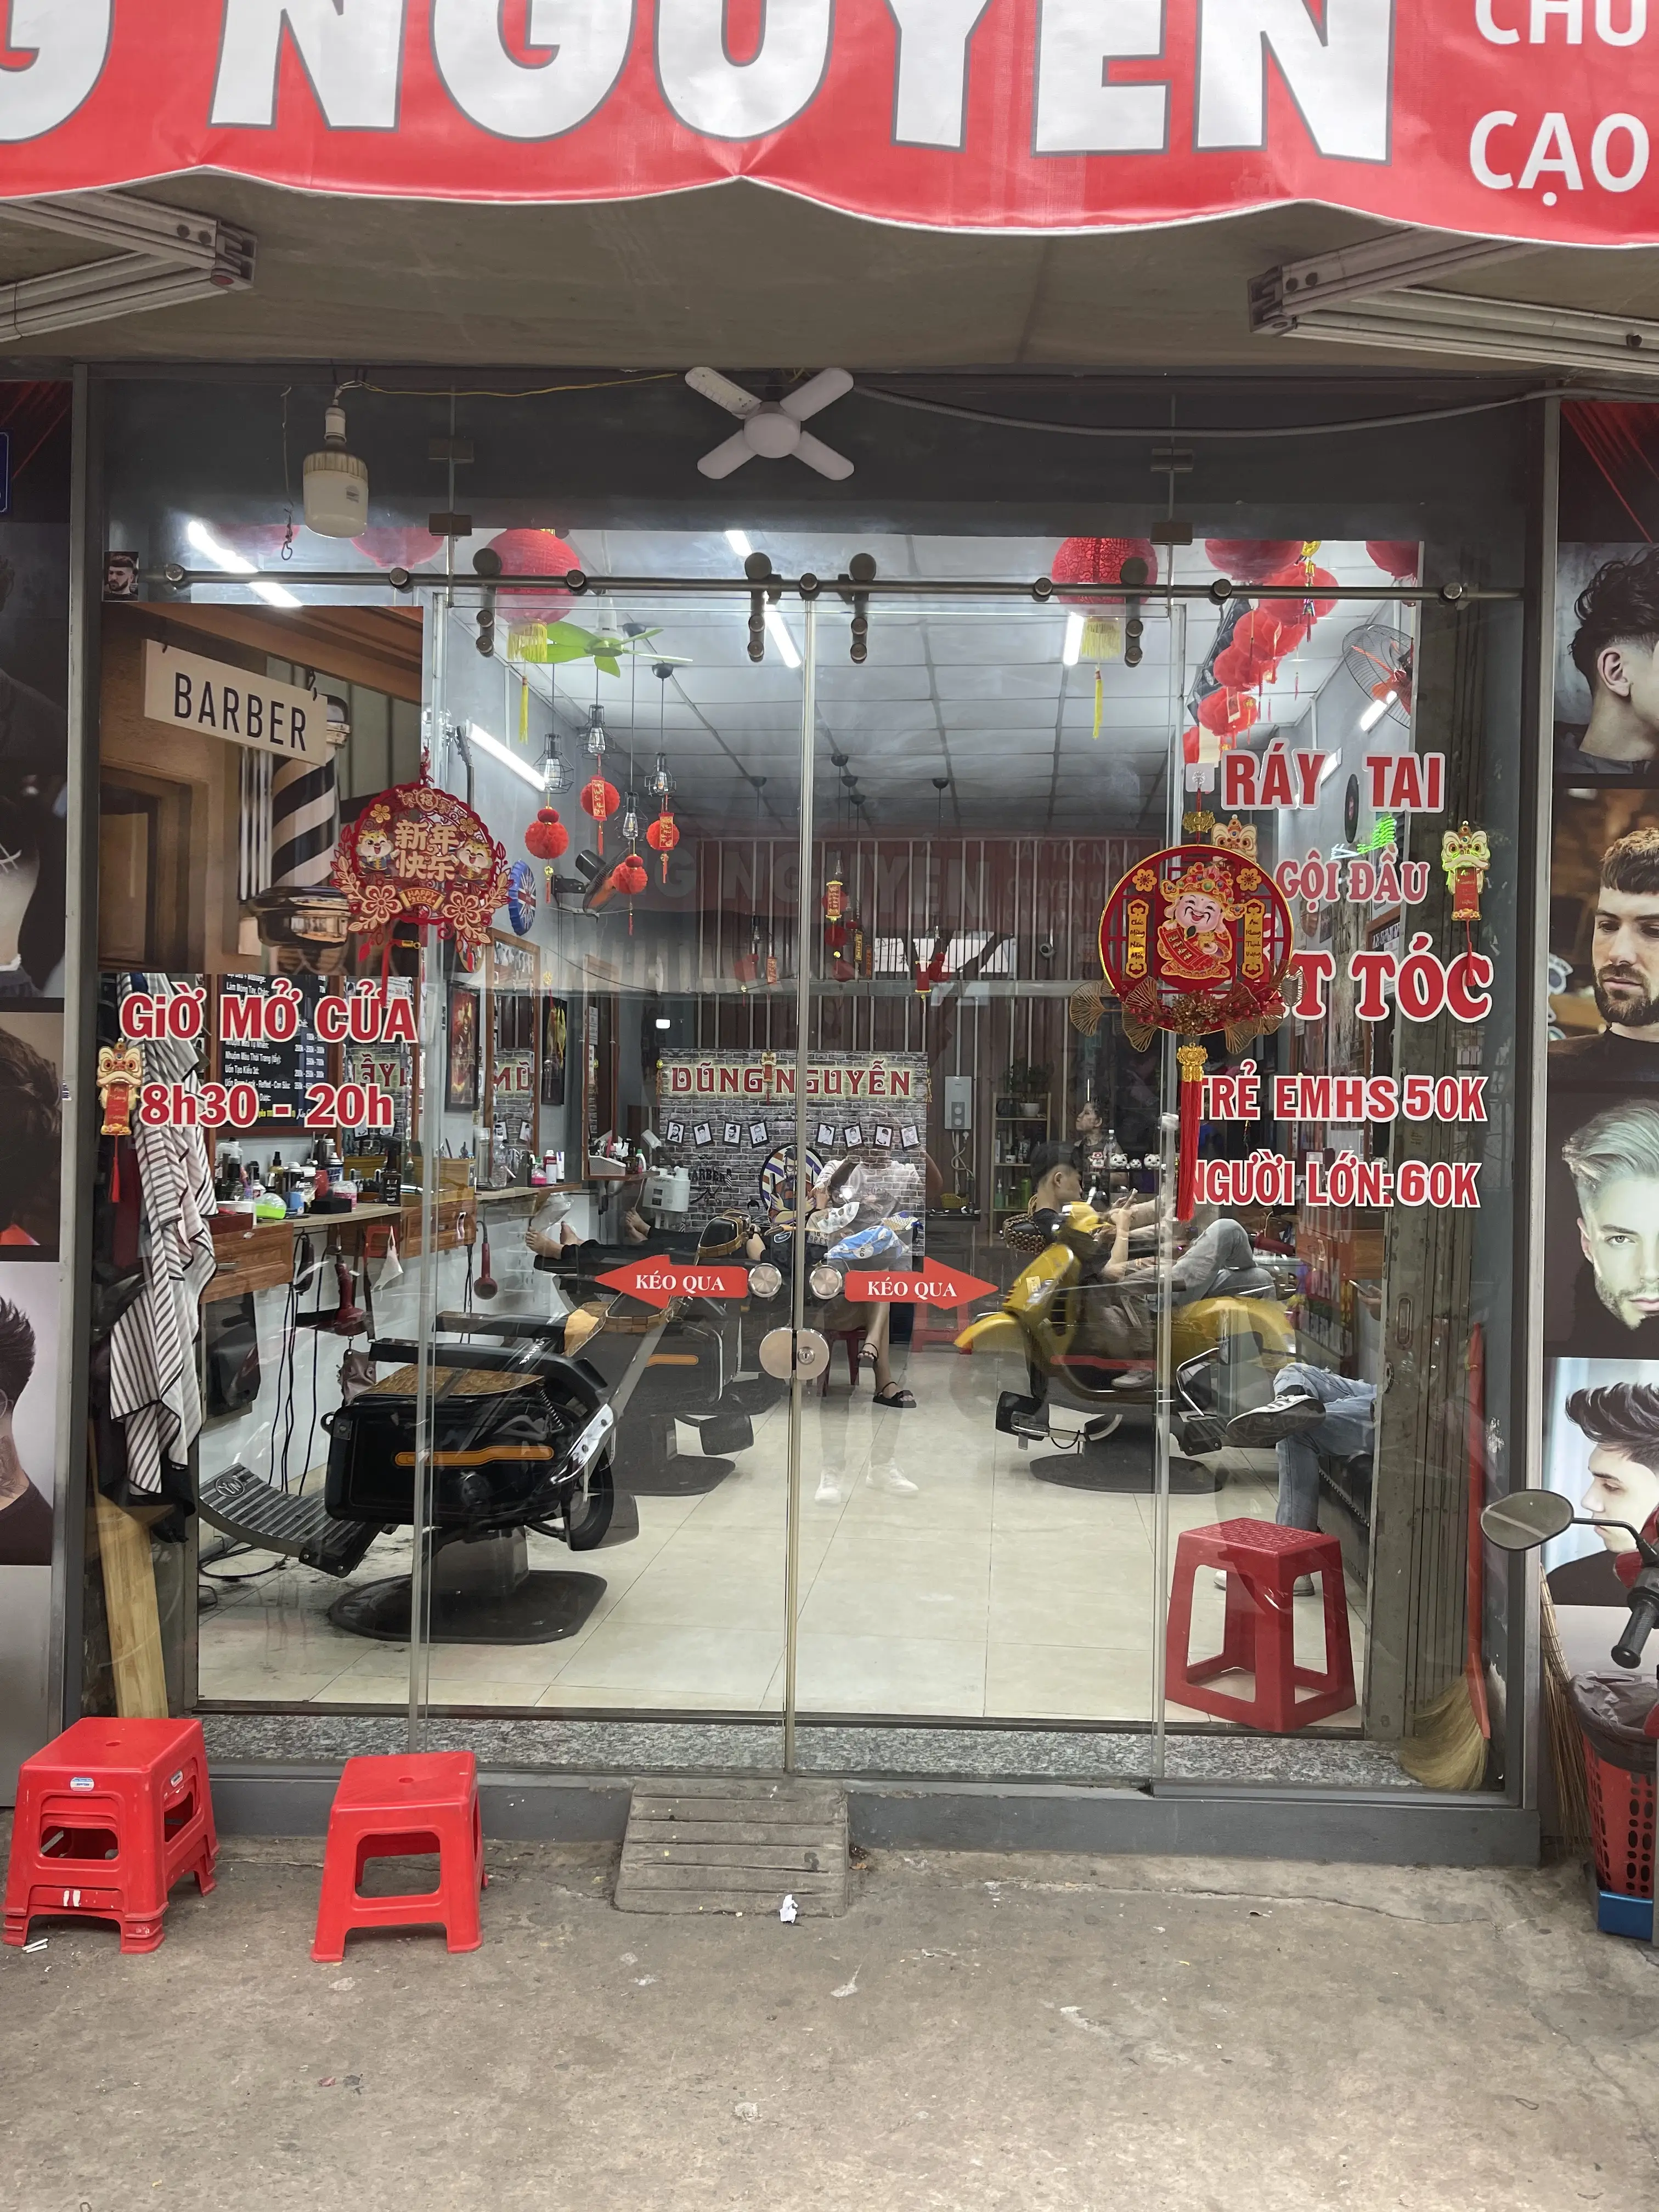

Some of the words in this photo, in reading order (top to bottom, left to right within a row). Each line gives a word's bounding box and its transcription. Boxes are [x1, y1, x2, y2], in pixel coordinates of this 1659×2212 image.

[1469, 110, 1650, 206] CẠO
[174, 672, 307, 752] BARBER
[1225, 742, 1326, 806] RÁY
[1366, 756, 1442, 809] TAI
[394, 819, 459, 855] 新年
[396, 850, 455, 882] 快乐
[1276, 850, 1339, 911] GỘI
[1348, 844, 1429, 903] ĐẦU
[407, 889, 438, 899] HAPPY
[1350, 935, 1491, 1020] TÓC
[221, 979, 301, 1041] MỞ
[315, 980, 417, 1041] CỬA
[672, 1062, 763, 1093] DŨNG
[775, 1059, 910, 1096] NGUYỄN
[140, 1084, 258, 1126] 8h30
[306, 1084, 393, 1126] 20h
[690, 1168, 726, 1183] ARBER
[636, 1270, 676, 1290] KÉO
[682, 1276, 725, 1295] QUA
[867, 1277, 908, 1296] KÉO
[914, 1282, 957, 1300] QUA
